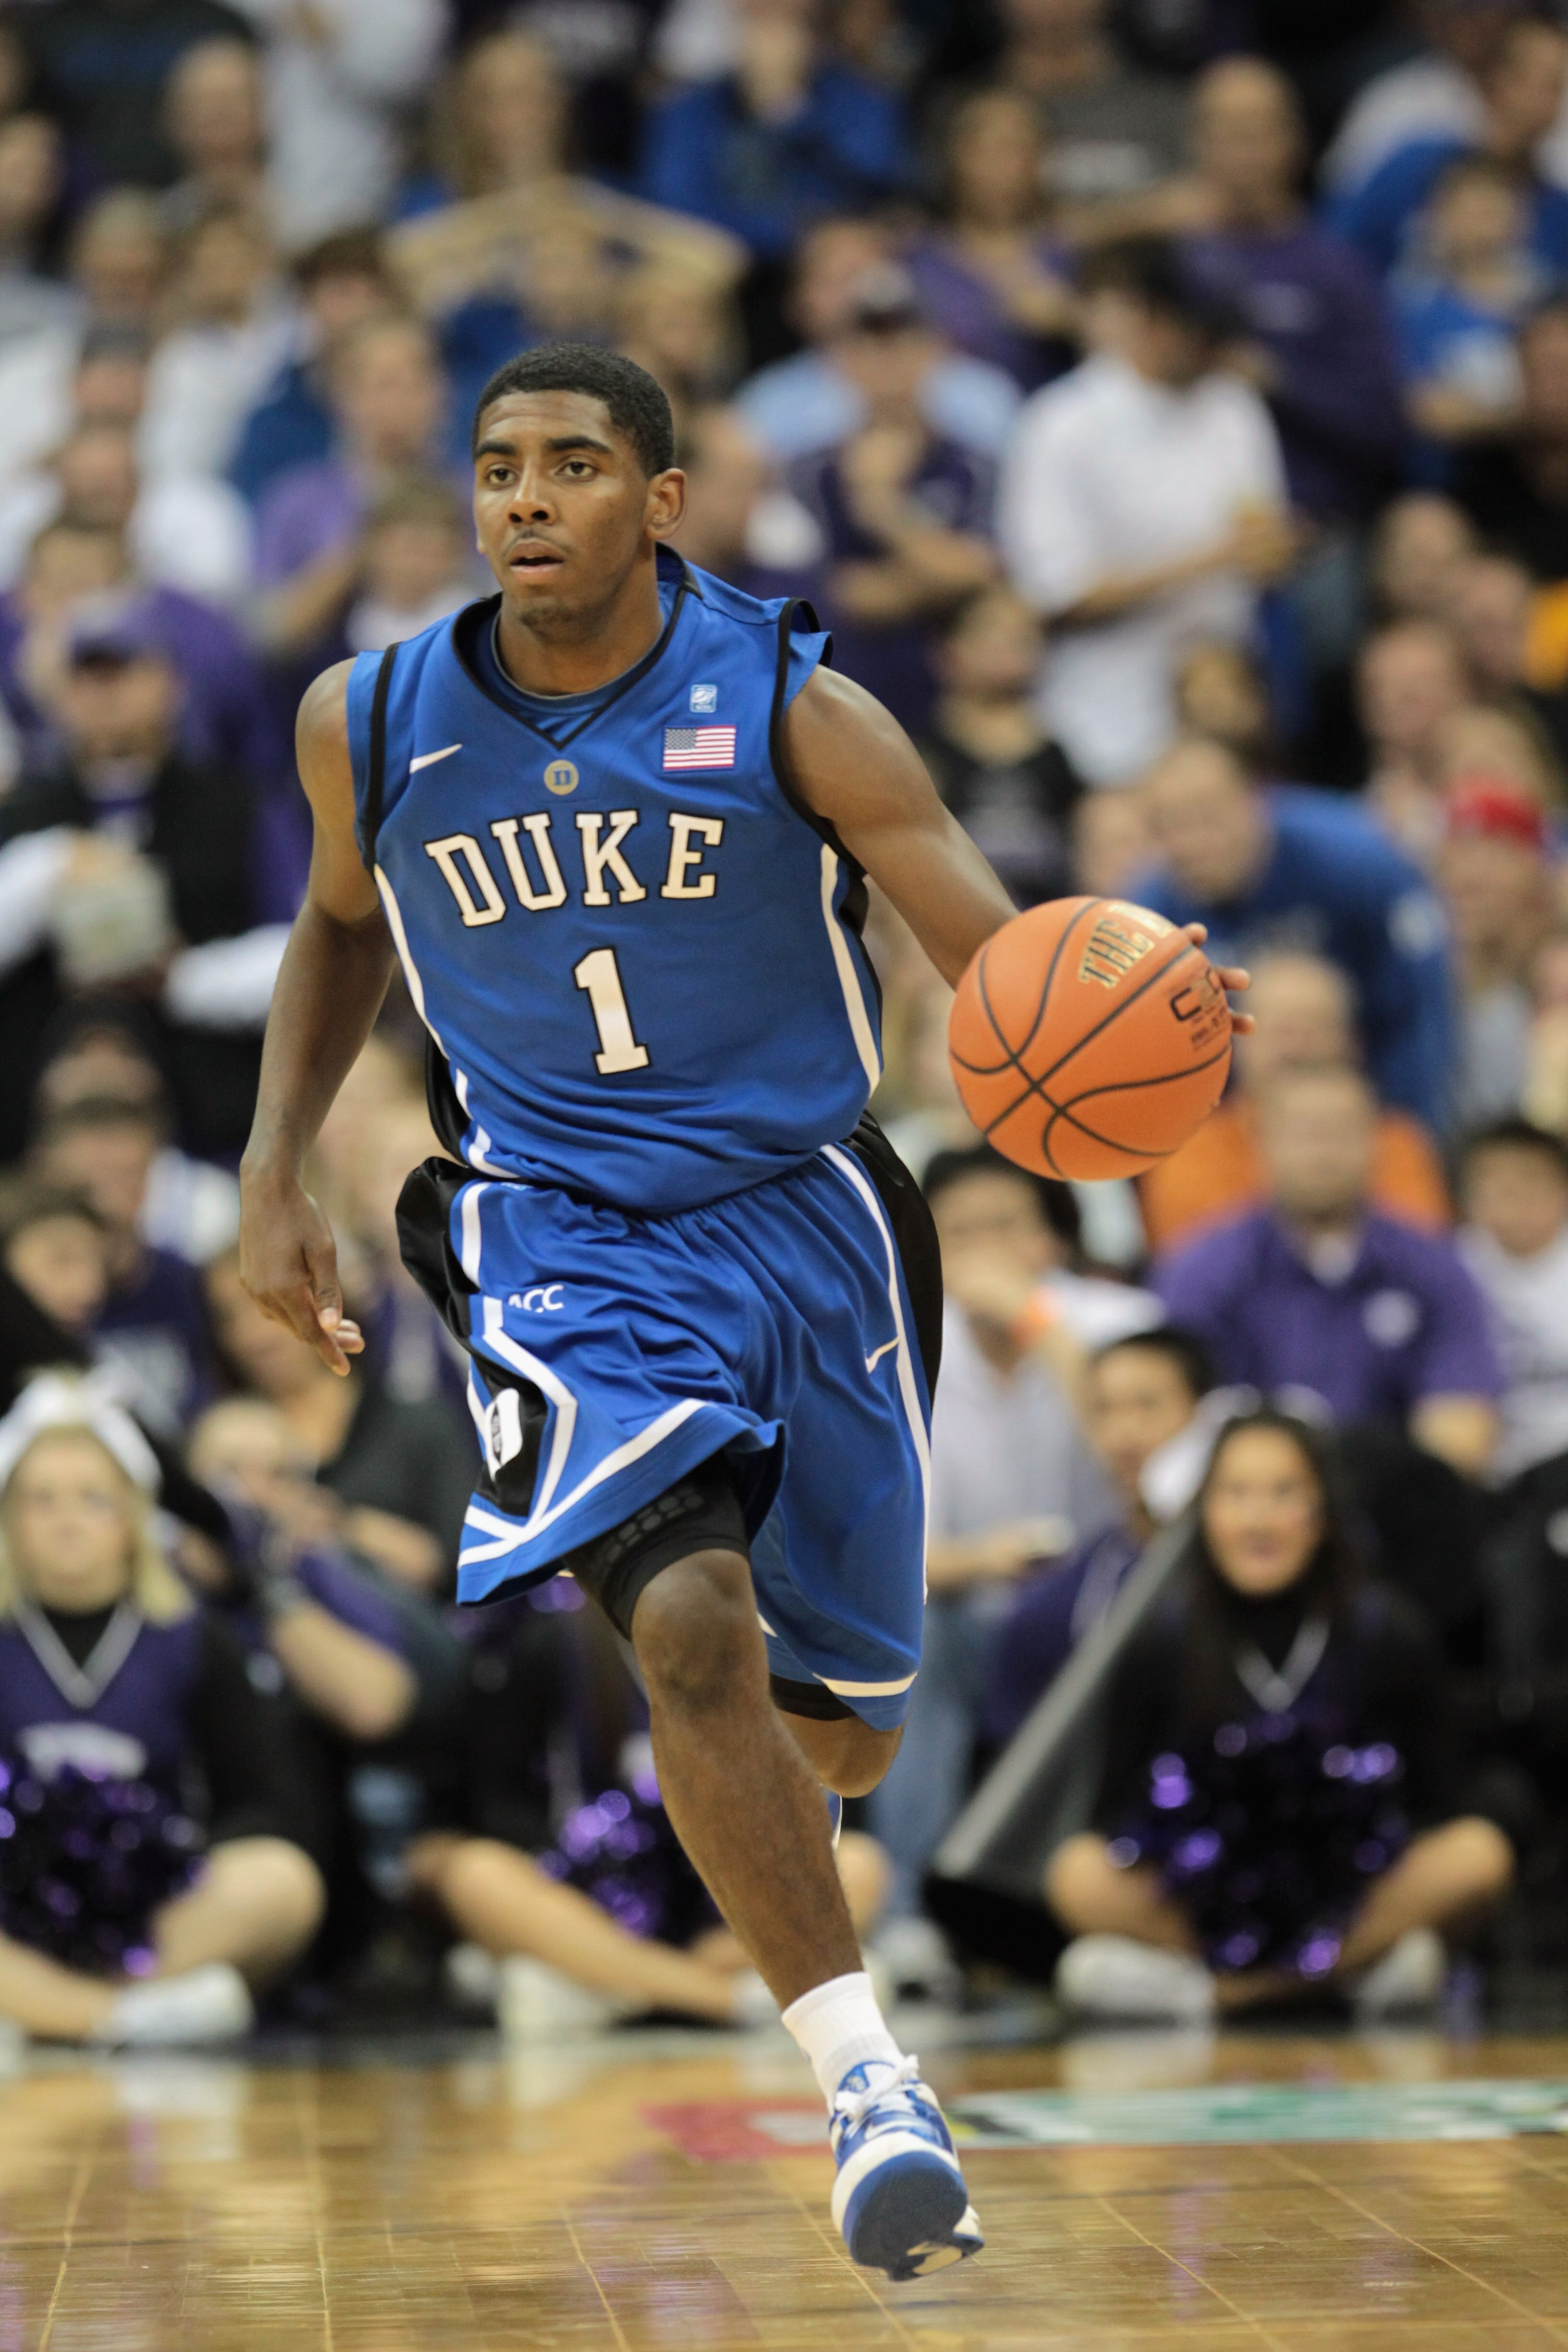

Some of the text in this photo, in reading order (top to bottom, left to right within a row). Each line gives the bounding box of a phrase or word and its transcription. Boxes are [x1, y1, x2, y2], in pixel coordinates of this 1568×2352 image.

[424, 808, 724, 928] DUKE
[1078, 919, 1155, 990] THE
[573, 945, 649, 1075] 1
[508, 1284, 564, 1313] ACC
